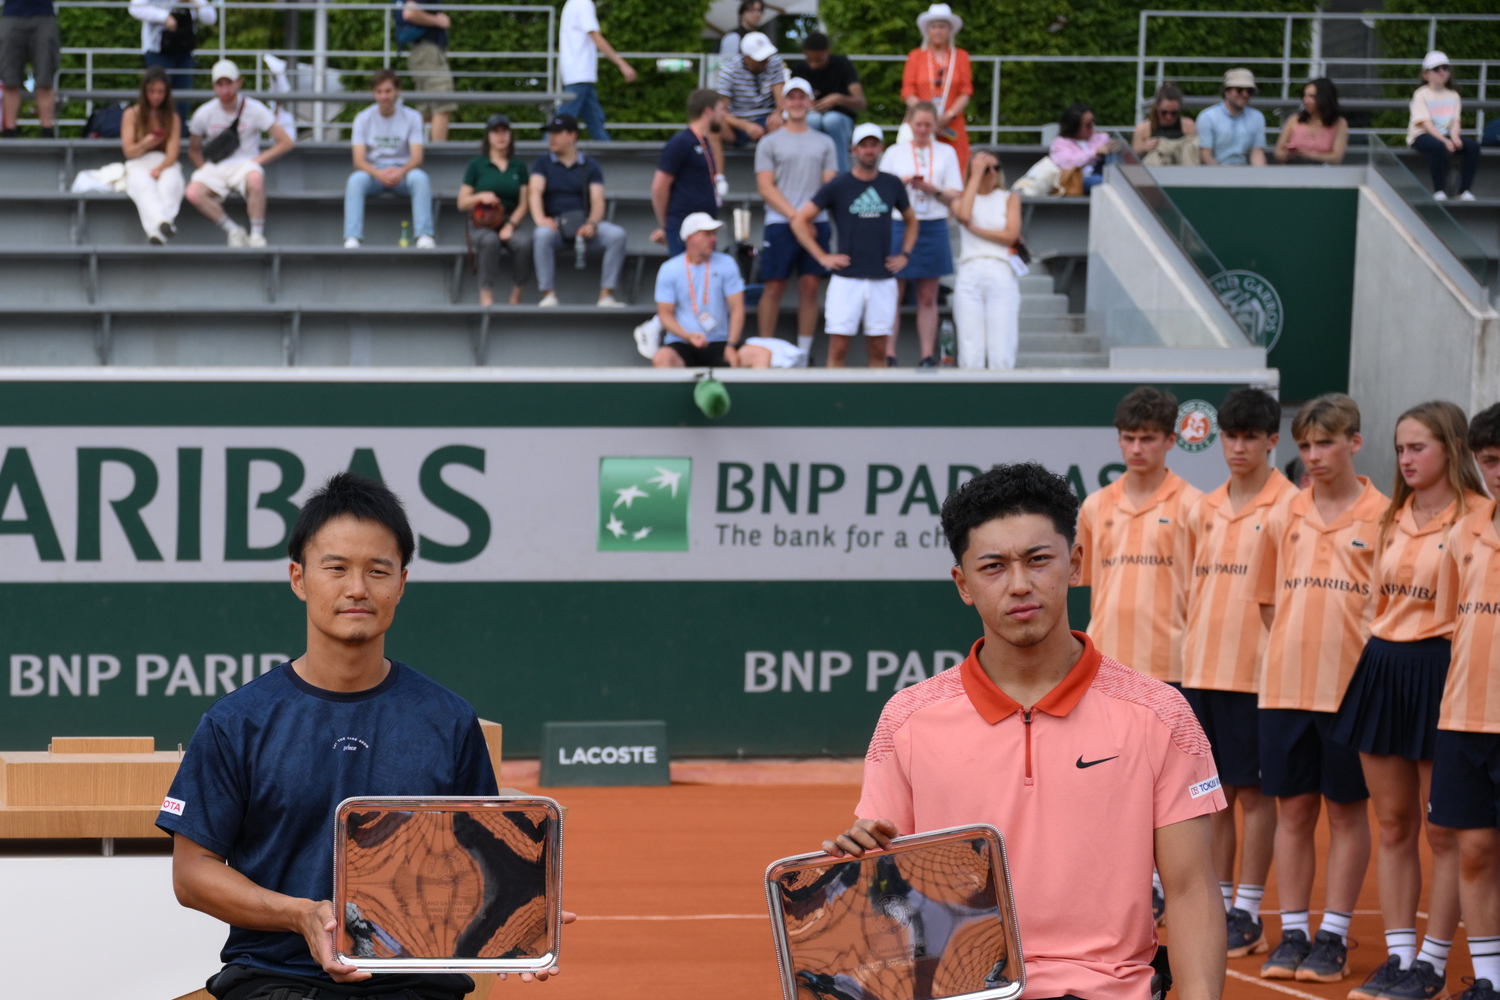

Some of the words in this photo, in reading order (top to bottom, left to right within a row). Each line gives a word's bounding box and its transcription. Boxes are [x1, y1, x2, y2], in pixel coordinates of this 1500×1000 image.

[716, 461, 846, 515] BNP
[716, 524, 762, 547] The
[773, 524, 836, 547] bank
[844, 525, 884, 553] for
[895, 530, 909, 547] a
[1304, 576, 1370, 596] PARIBAS
[11, 654, 121, 696] BNP
[745, 651, 852, 692] BNP
[559, 745, 657, 766] LACOSTE
[163, 800, 181, 812] OTA
